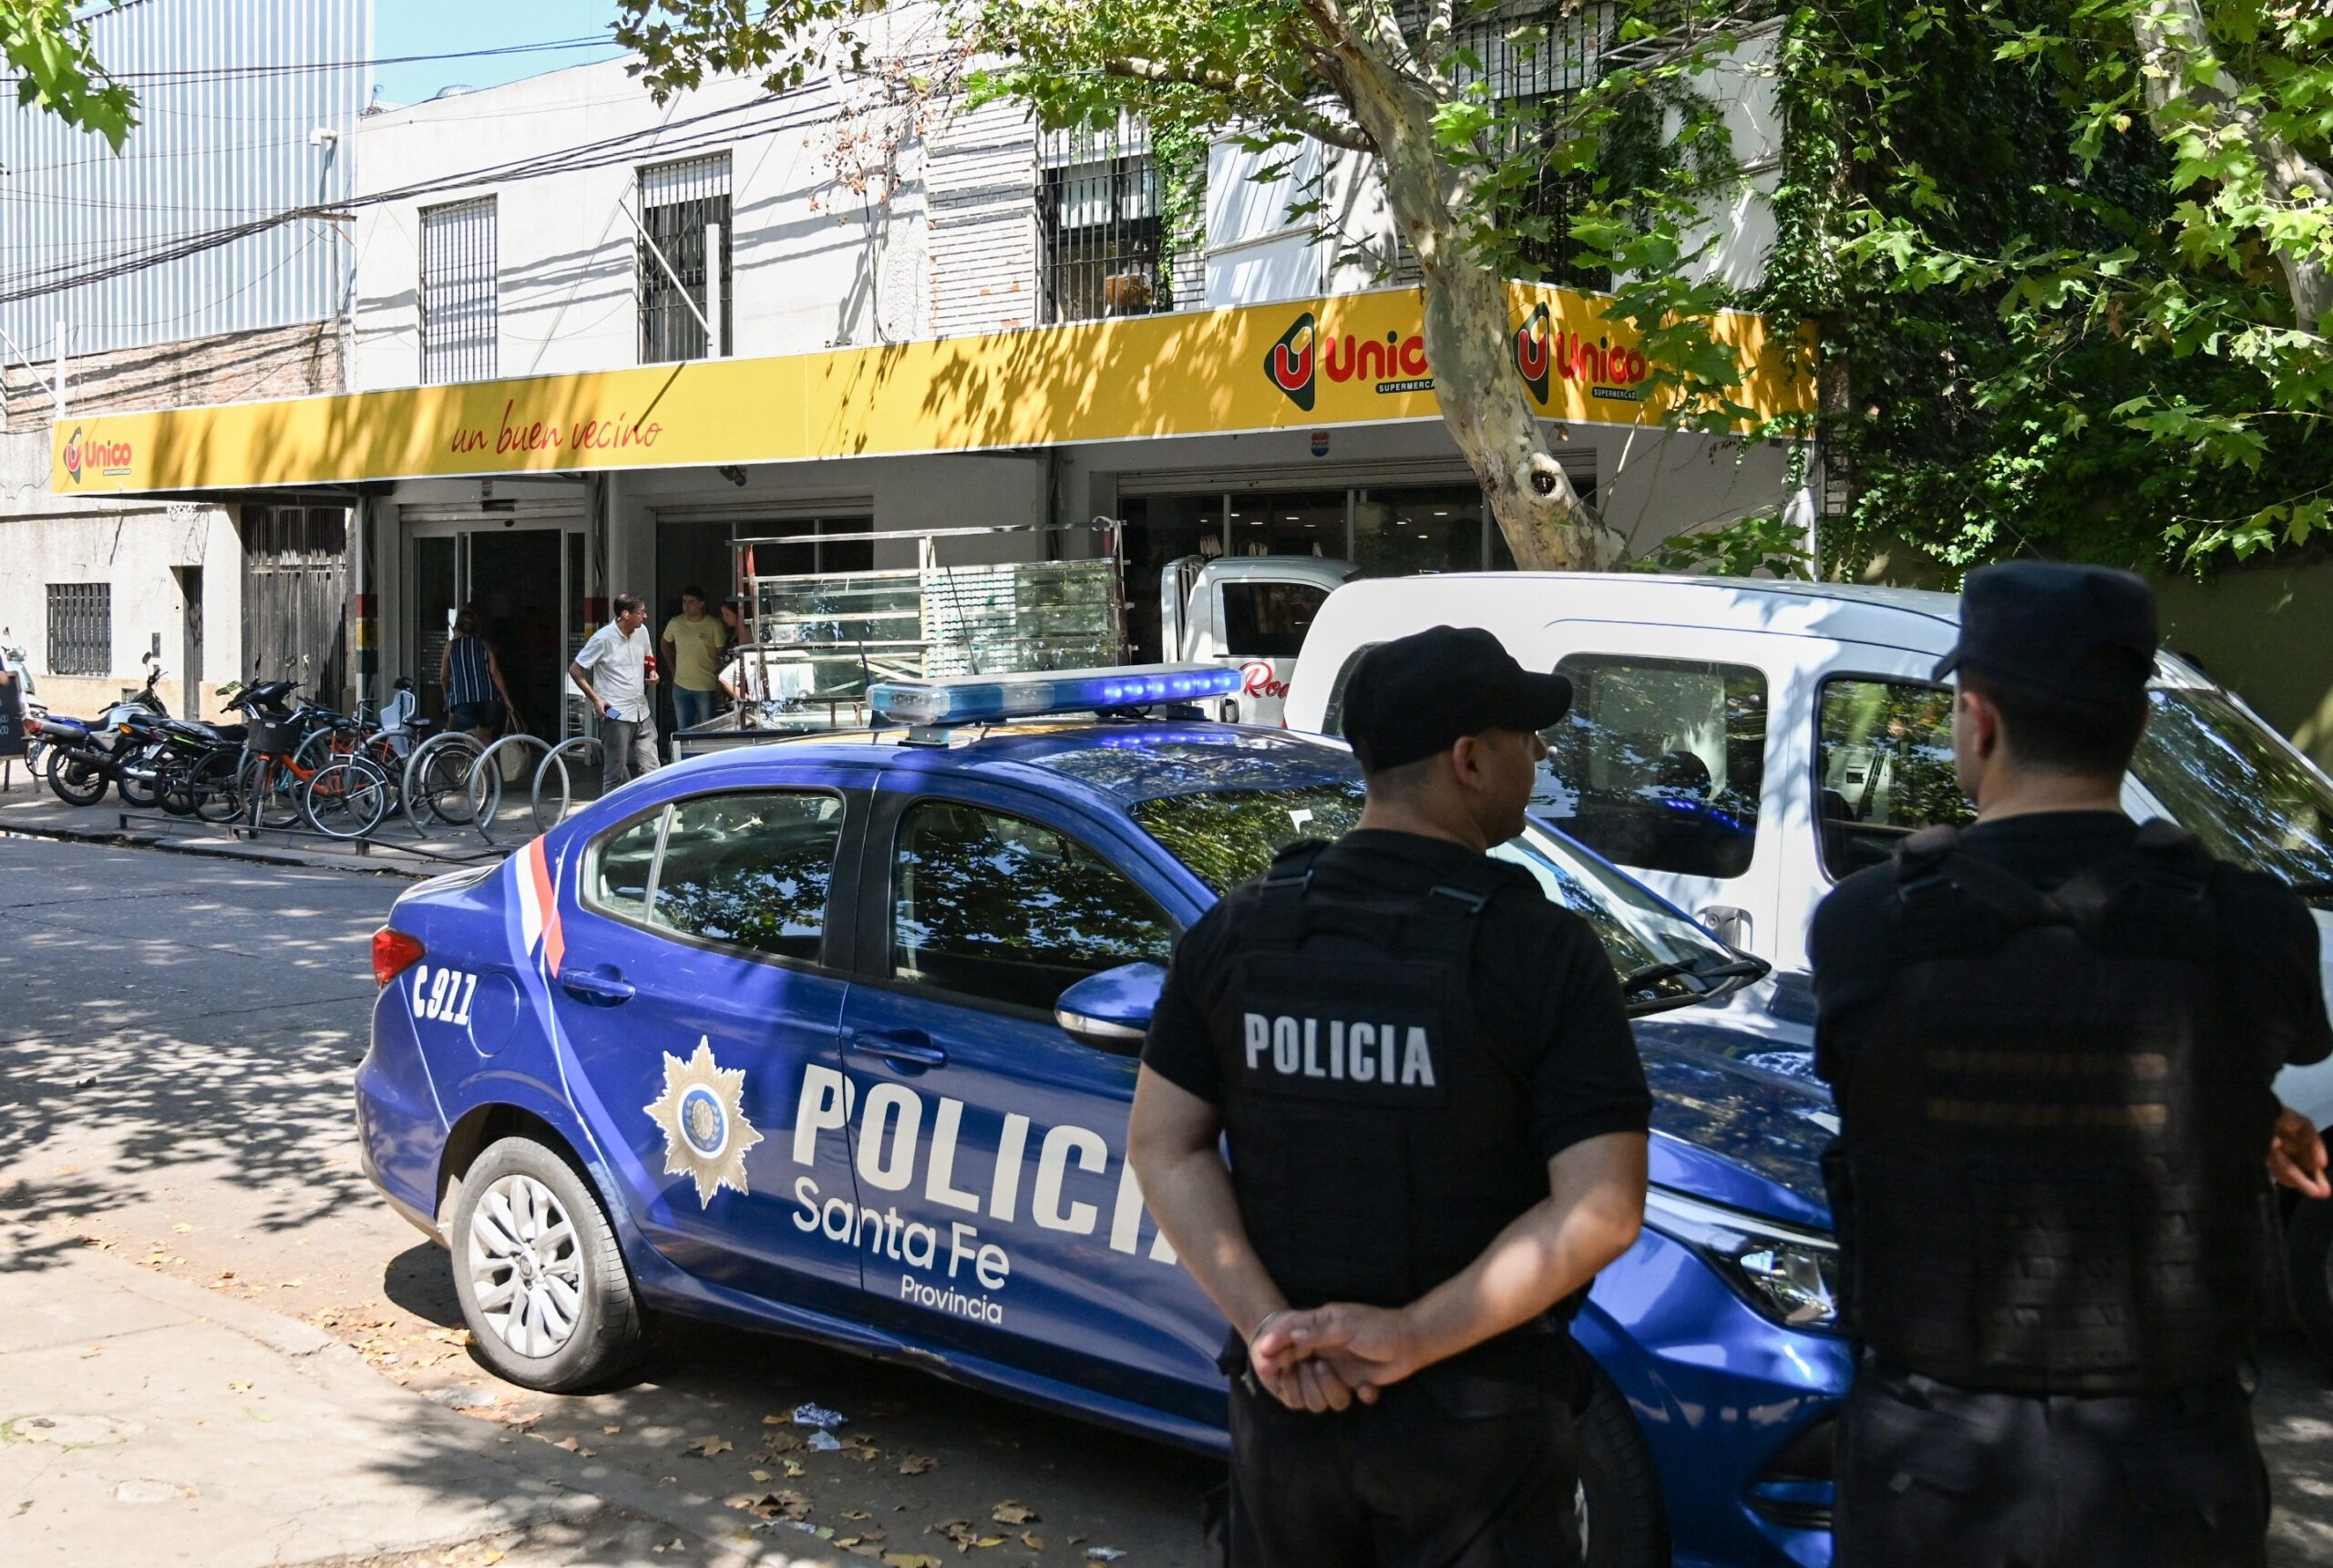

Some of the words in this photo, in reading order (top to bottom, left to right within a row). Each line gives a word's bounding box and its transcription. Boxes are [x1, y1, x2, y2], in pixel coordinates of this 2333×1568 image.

[1325, 331, 1429, 383] Unic
[1557, 331, 1646, 384] Unico
[1379, 381, 1435, 393] SUPERMERCA
[1594, 388, 1639, 400] SUPERMERCAD
[451, 427, 488, 454] un
[496, 398, 563, 455] buen
[571, 412, 663, 451] vecino
[85, 439, 132, 467] Unico
[1244, 1012, 1436, 1087] POLICIA
[793, 1063, 1178, 1266] POLICI
[793, 1176, 936, 1270] Santa
[949, 1222, 1011, 1290] Fe
[901, 1274, 1002, 1324] Provincia
